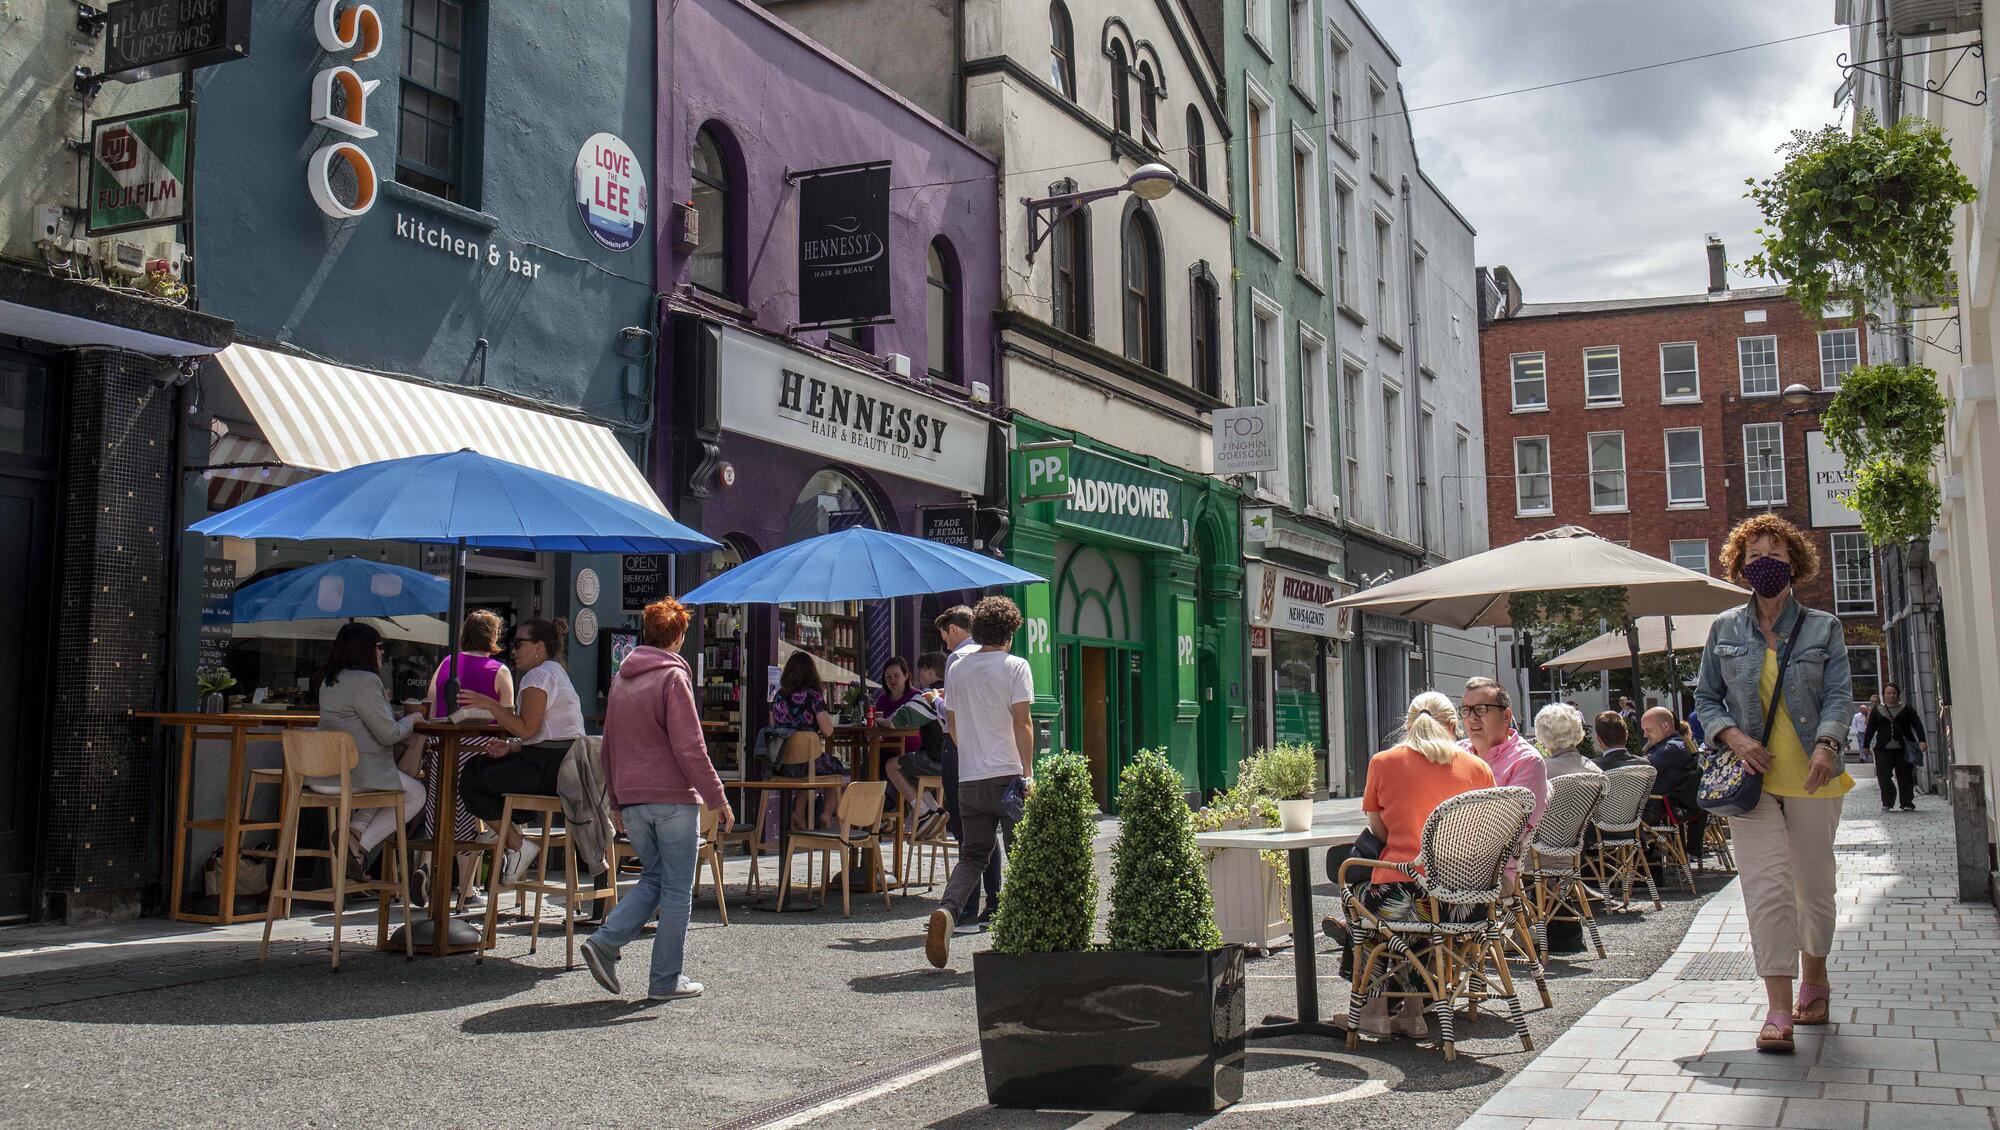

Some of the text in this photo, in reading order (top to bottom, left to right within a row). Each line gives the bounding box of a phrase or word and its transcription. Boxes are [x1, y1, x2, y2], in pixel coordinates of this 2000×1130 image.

[129, 4, 169, 33] LATE
[130, 23, 211, 59] UPSTAIRS
[595, 144, 631, 178] LOVE
[607, 172, 618, 182] THE
[595, 176, 630, 217] LEE
[396, 213, 541, 279] kitchen & bar
[804, 233, 872, 260] HENNESSY
[814, 270, 833, 278] HAIR
[843, 265, 874, 275] BEAUTY
[778, 368, 948, 453] HENNESSY
[811, 420, 911, 460] HAIR & BEAUTY LTD.
[1029, 456, 1066, 486] PP.
[933, 519, 960, 528] TRADE
[936, 527, 965, 536] RETAIL
[626, 556, 658, 569] OPEN
[624, 573, 662, 583] BREAKFAST
[630, 584, 654, 593] LUNCH
[1282, 576, 1335, 605] FITZGERALDS
[1289, 606, 1325, 626] NEWSAGENTS
[1027, 617, 1051, 654] PP.
[1178, 635, 1195, 666] PP.
